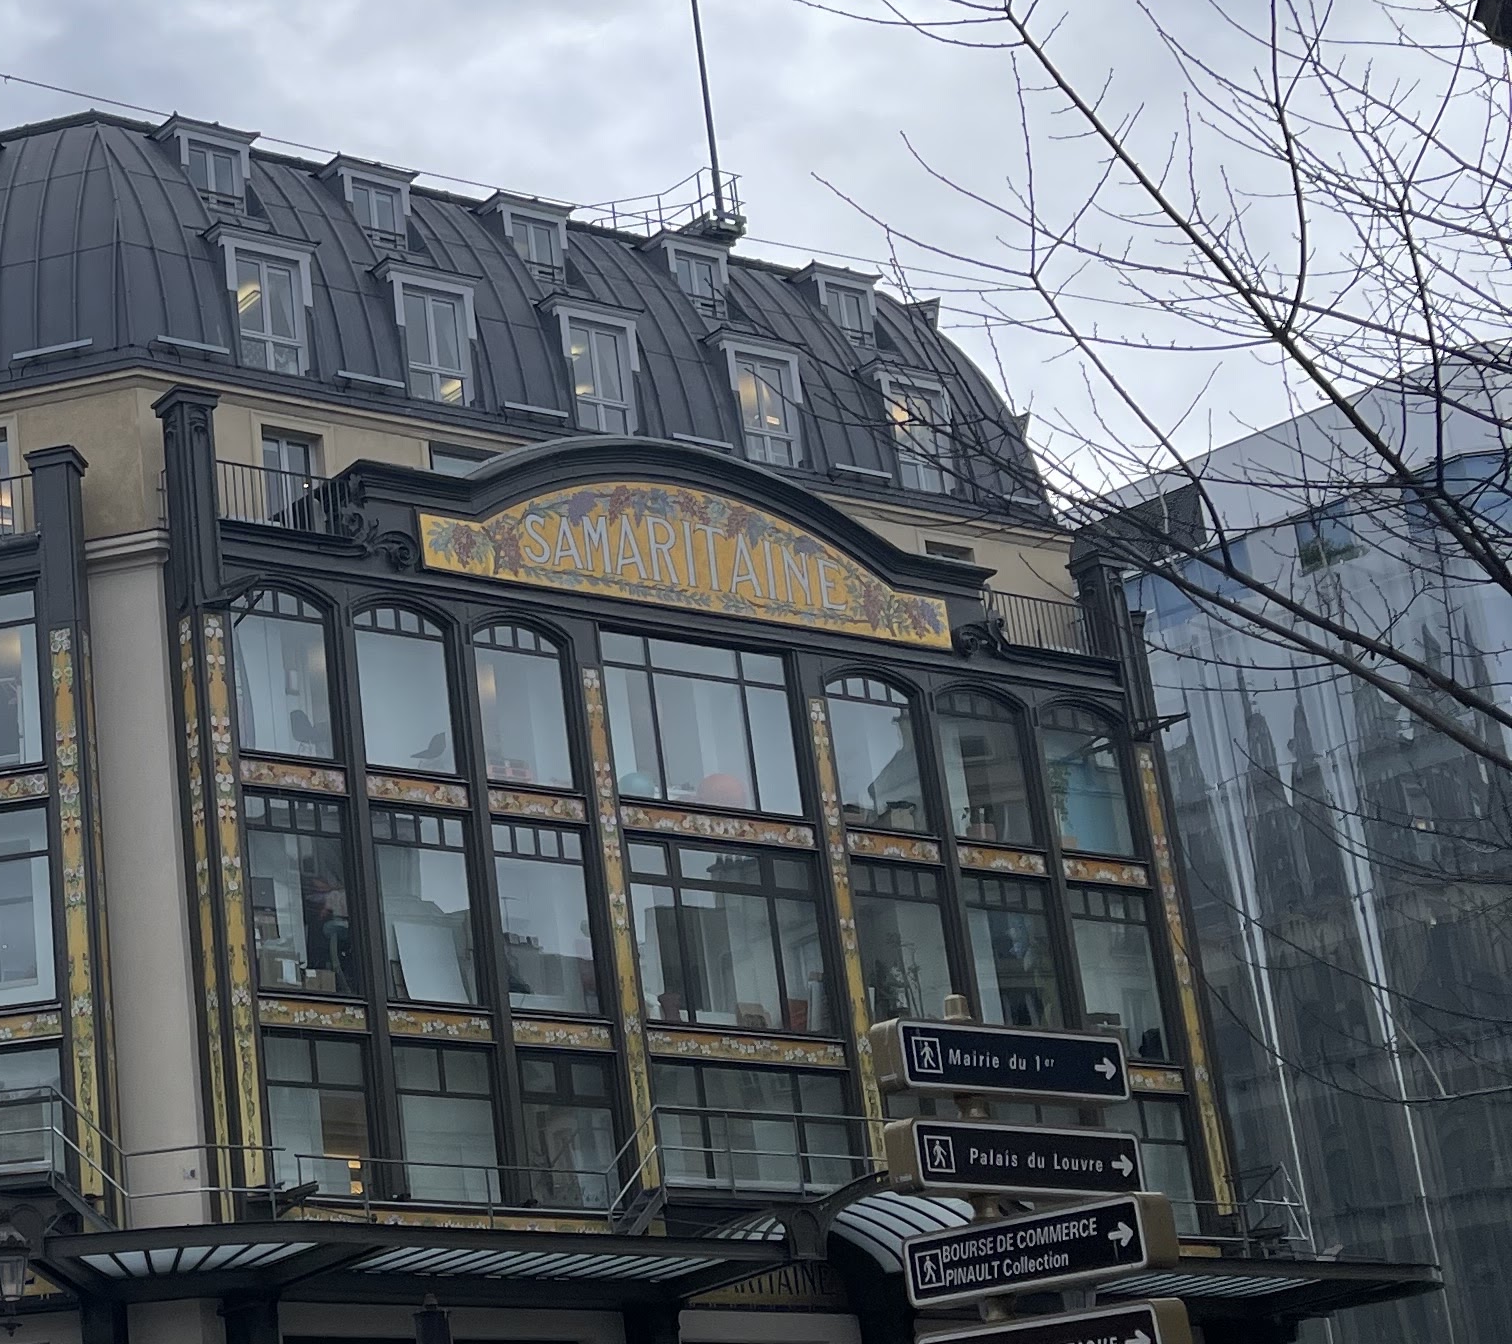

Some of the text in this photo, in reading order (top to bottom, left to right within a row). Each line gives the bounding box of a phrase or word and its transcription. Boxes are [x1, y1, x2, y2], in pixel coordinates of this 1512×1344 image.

[523, 513, 848, 611] SAMARITAINE
[948, 1048, 1000, 1069] Mairie
[1009, 1053, 1027, 1071] du
[969, 1147, 1104, 1172] Palais du Louvre
[942, 1217, 1098, 1263] BOURSE DE COMMERCE
[945, 1250, 1069, 1287] PINAULT Collection
